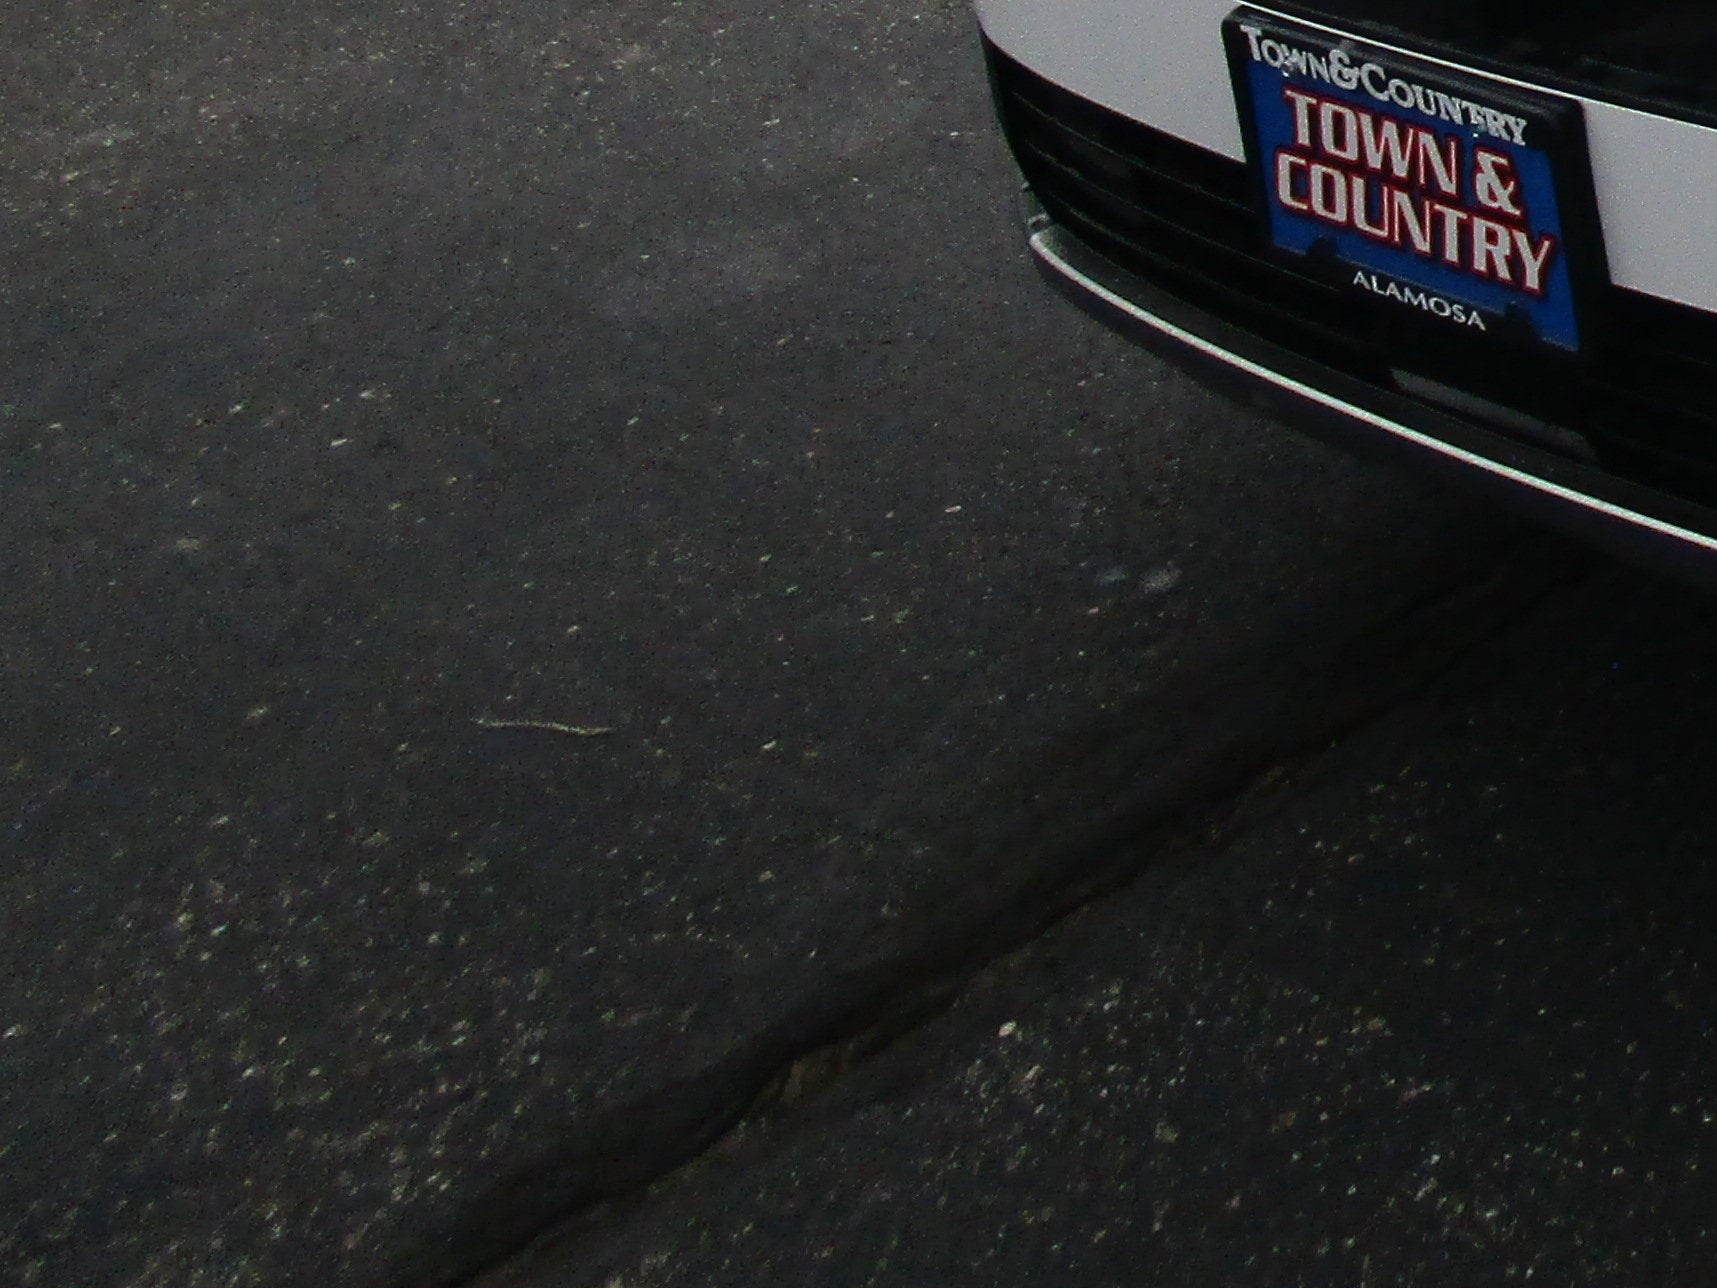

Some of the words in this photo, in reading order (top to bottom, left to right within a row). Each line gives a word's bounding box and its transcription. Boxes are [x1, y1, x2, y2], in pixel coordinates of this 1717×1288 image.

[1283, 86, 1460, 199] TOWN
[1473, 148, 1522, 217] &
[1276, 151, 1553, 293] COUNTRY
[1352, 270, 1487, 332] ALAMOSA
